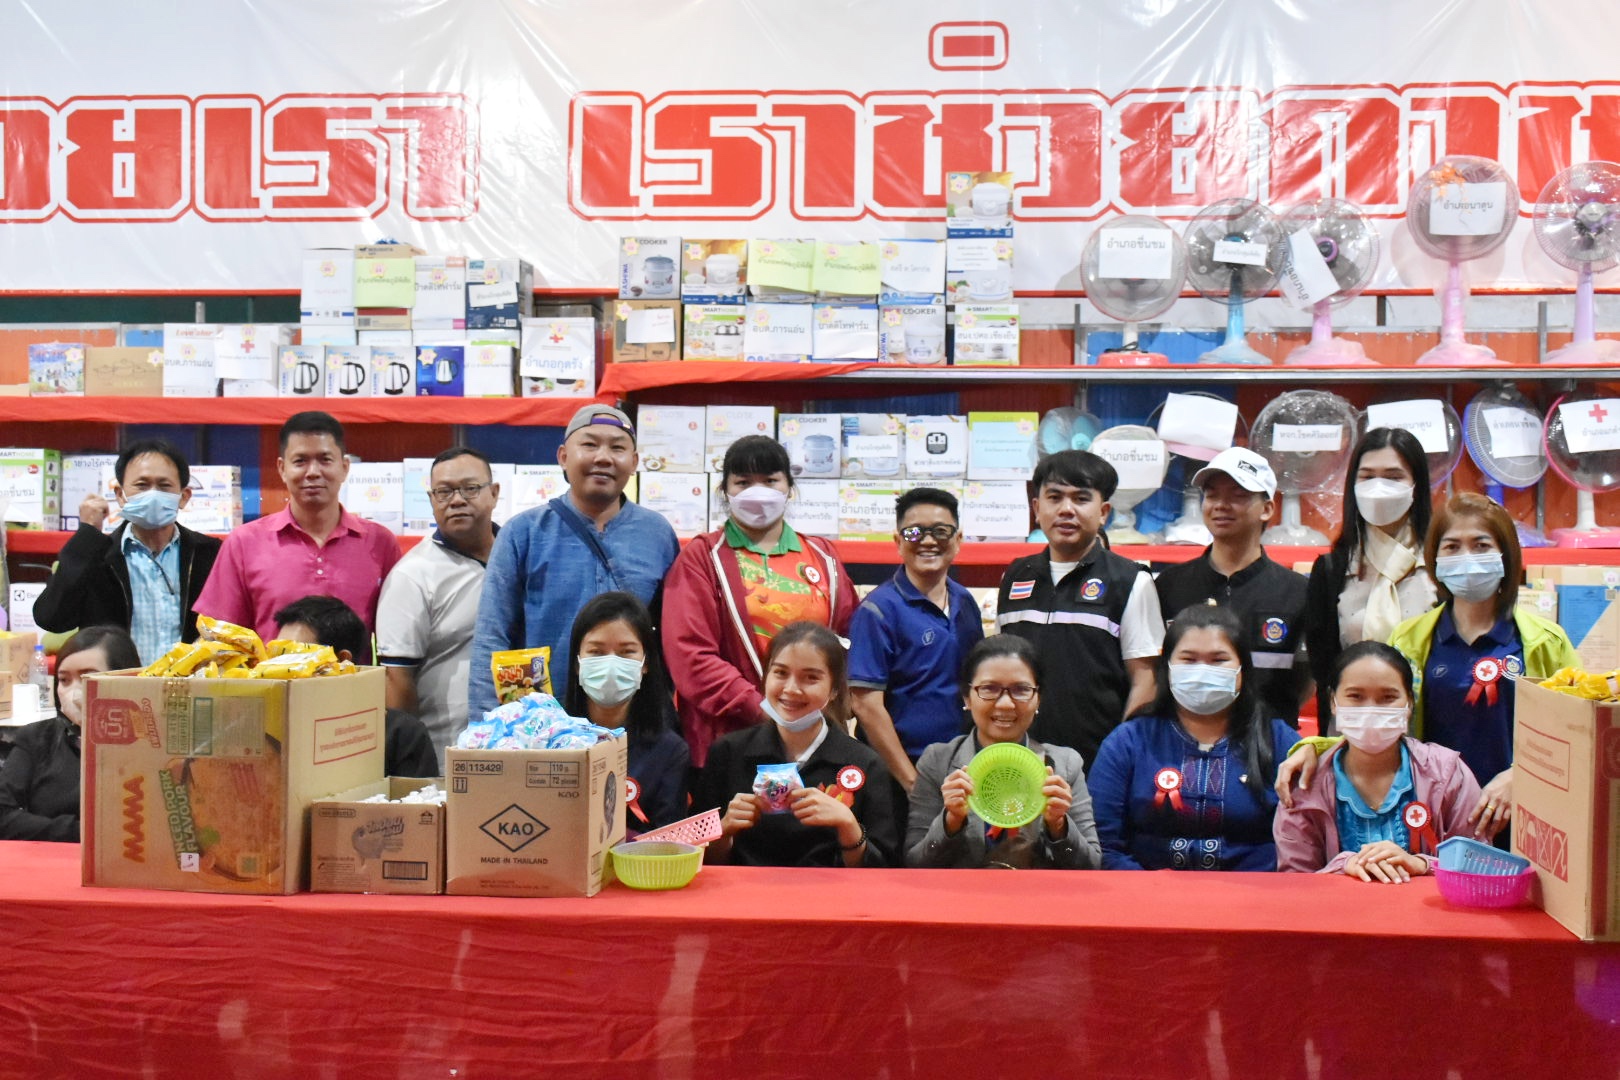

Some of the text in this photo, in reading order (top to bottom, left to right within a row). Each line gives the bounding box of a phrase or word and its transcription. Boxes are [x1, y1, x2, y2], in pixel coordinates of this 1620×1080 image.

[1107, 235, 1166, 249] อำเภอชื่นชม
[525, 354, 583, 374] อำเภอกุดรัง
[454, 763, 501, 772] 26 113429
[552, 763, 564, 772] 110
[552, 777, 560, 785] 72
[160, 769, 176, 808] PORK
[123, 775, 145, 863] MAMA
[175, 784, 198, 851] FLAVOUR
[498, 823, 534, 836] KAO
[514, 857, 548, 865] THAILAND
